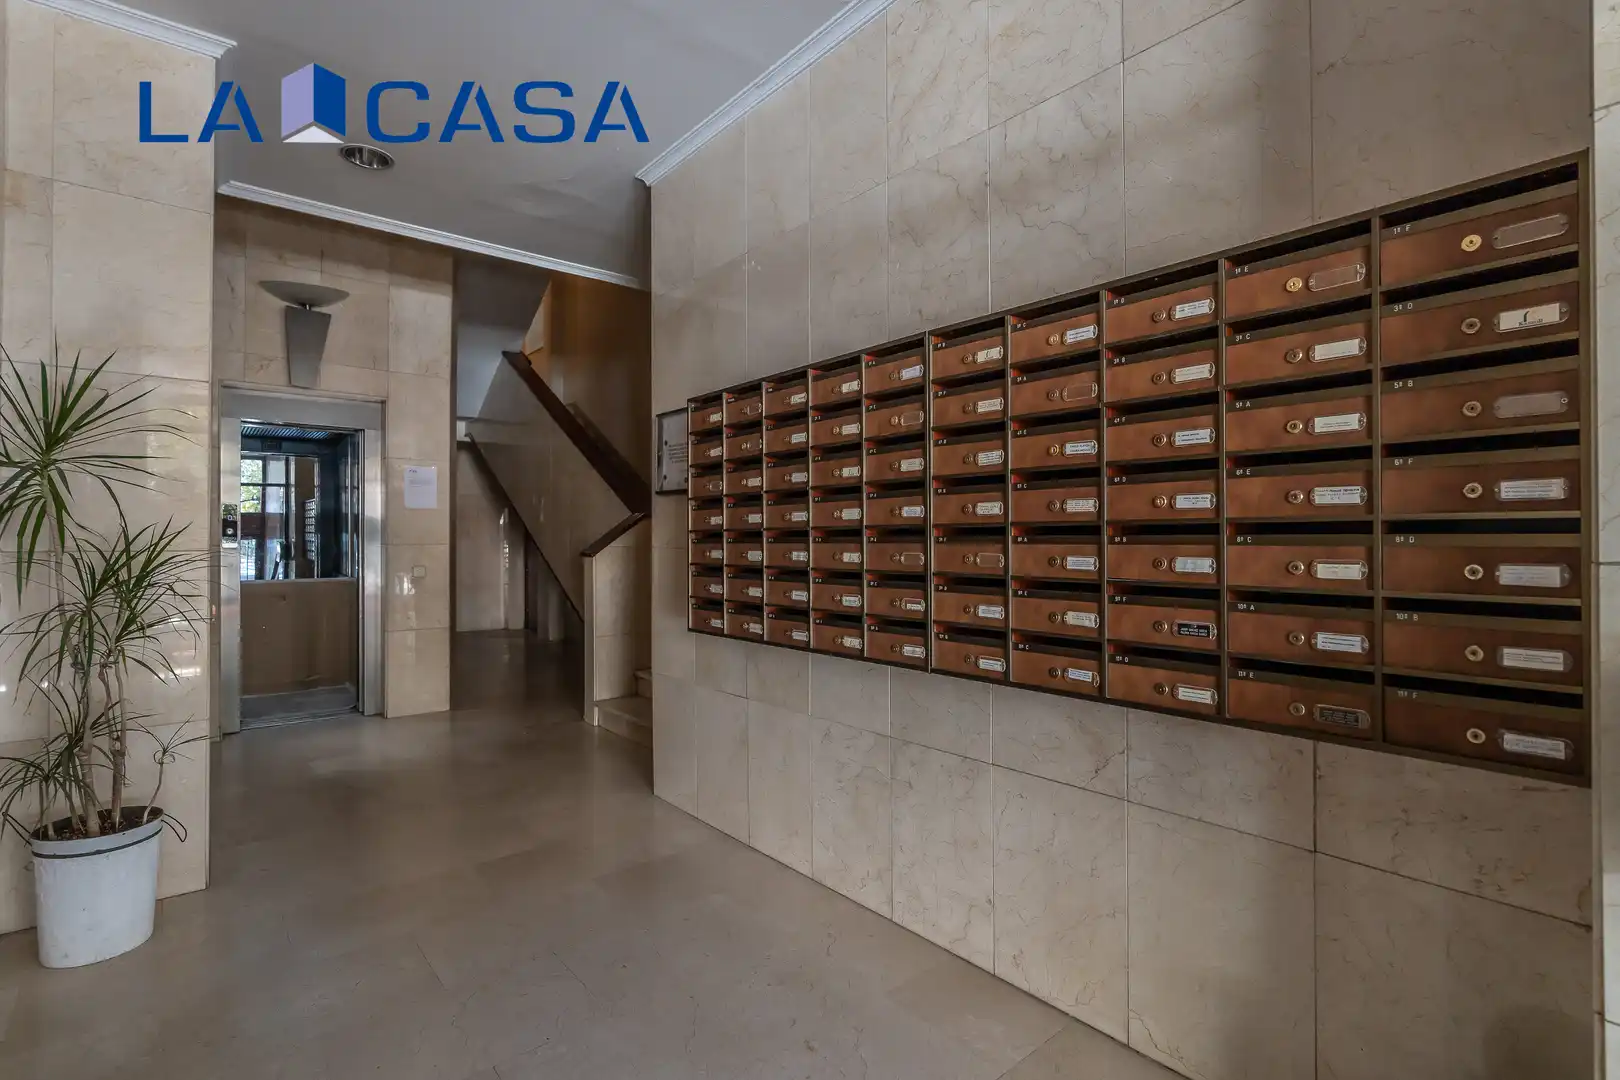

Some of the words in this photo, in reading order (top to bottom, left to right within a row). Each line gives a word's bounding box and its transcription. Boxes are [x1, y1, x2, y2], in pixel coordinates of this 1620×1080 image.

[1405, 224, 1411, 232] F
[1244, 265, 1249, 273] E
[1413, 613, 1419, 621] B
[1249, 671, 1254, 679] E
